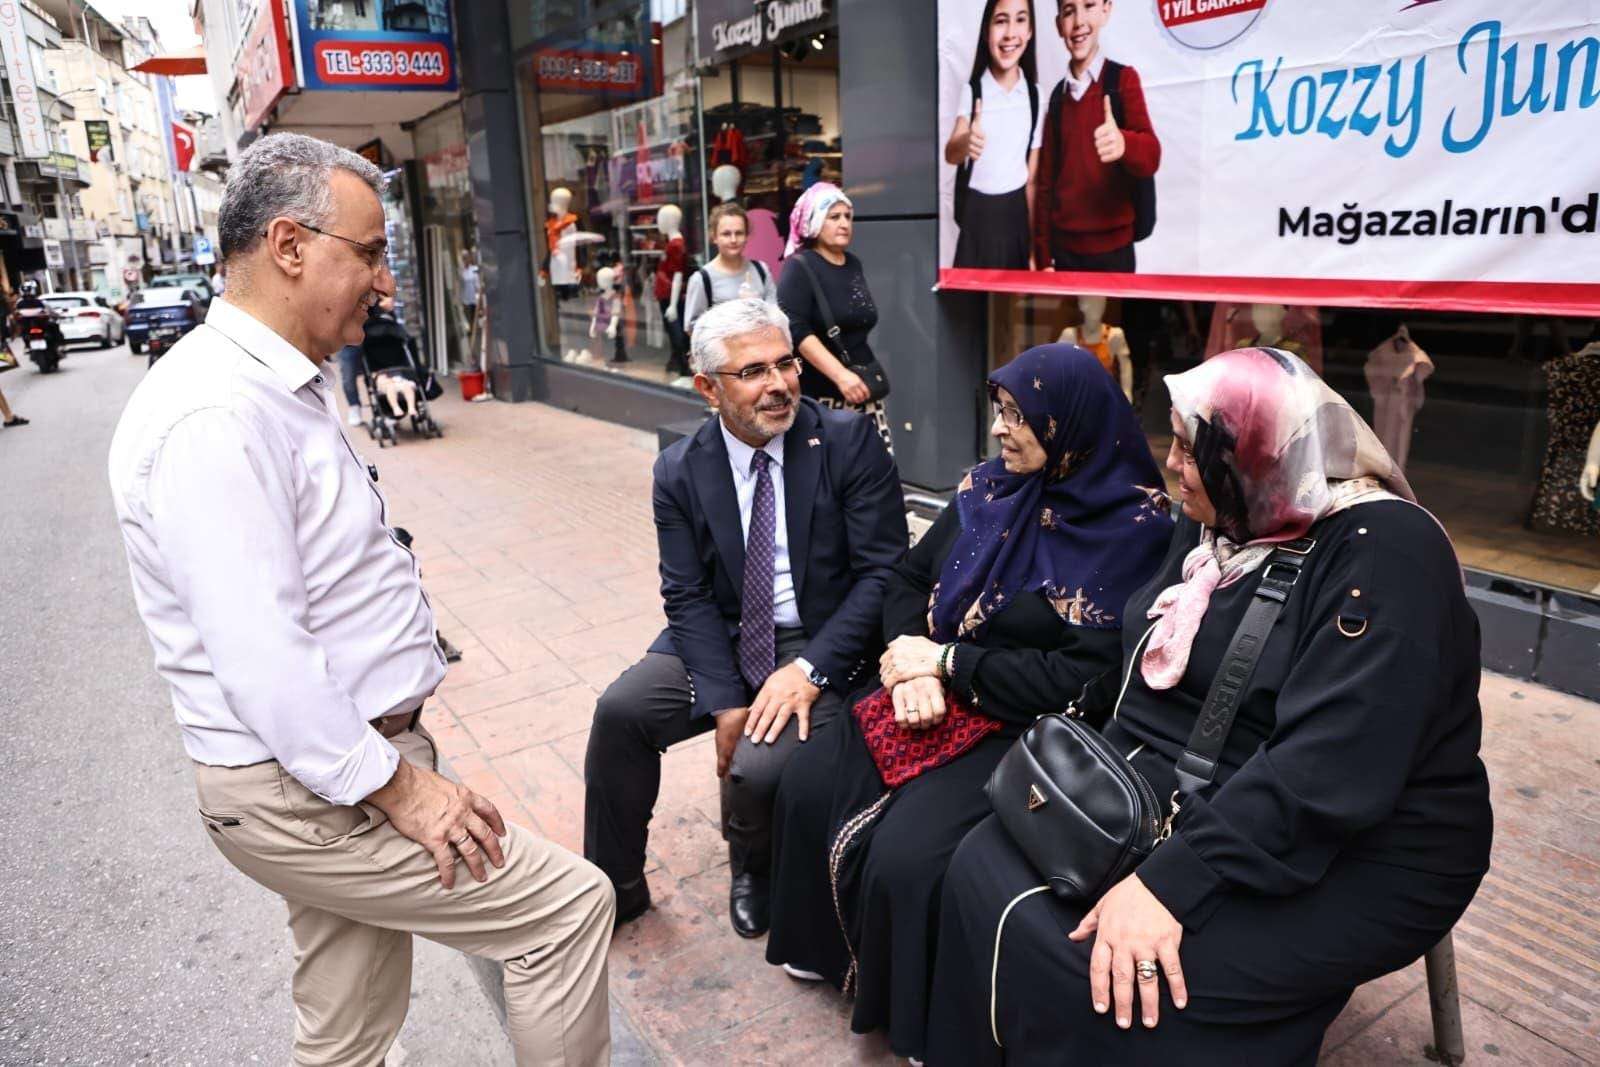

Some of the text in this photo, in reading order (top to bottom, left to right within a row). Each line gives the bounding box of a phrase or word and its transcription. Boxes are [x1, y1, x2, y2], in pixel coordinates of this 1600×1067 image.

[1163, 3, 1170, 20] 1
[712, 13, 762, 50] Kozzy
[361, 51, 395, 75] 333
[397, 52, 409, 75] 3
[411, 51, 443, 75] 444
[1232, 55, 1426, 158] Kozzy
[1278, 193, 1599, 245] Mağazaların'd
